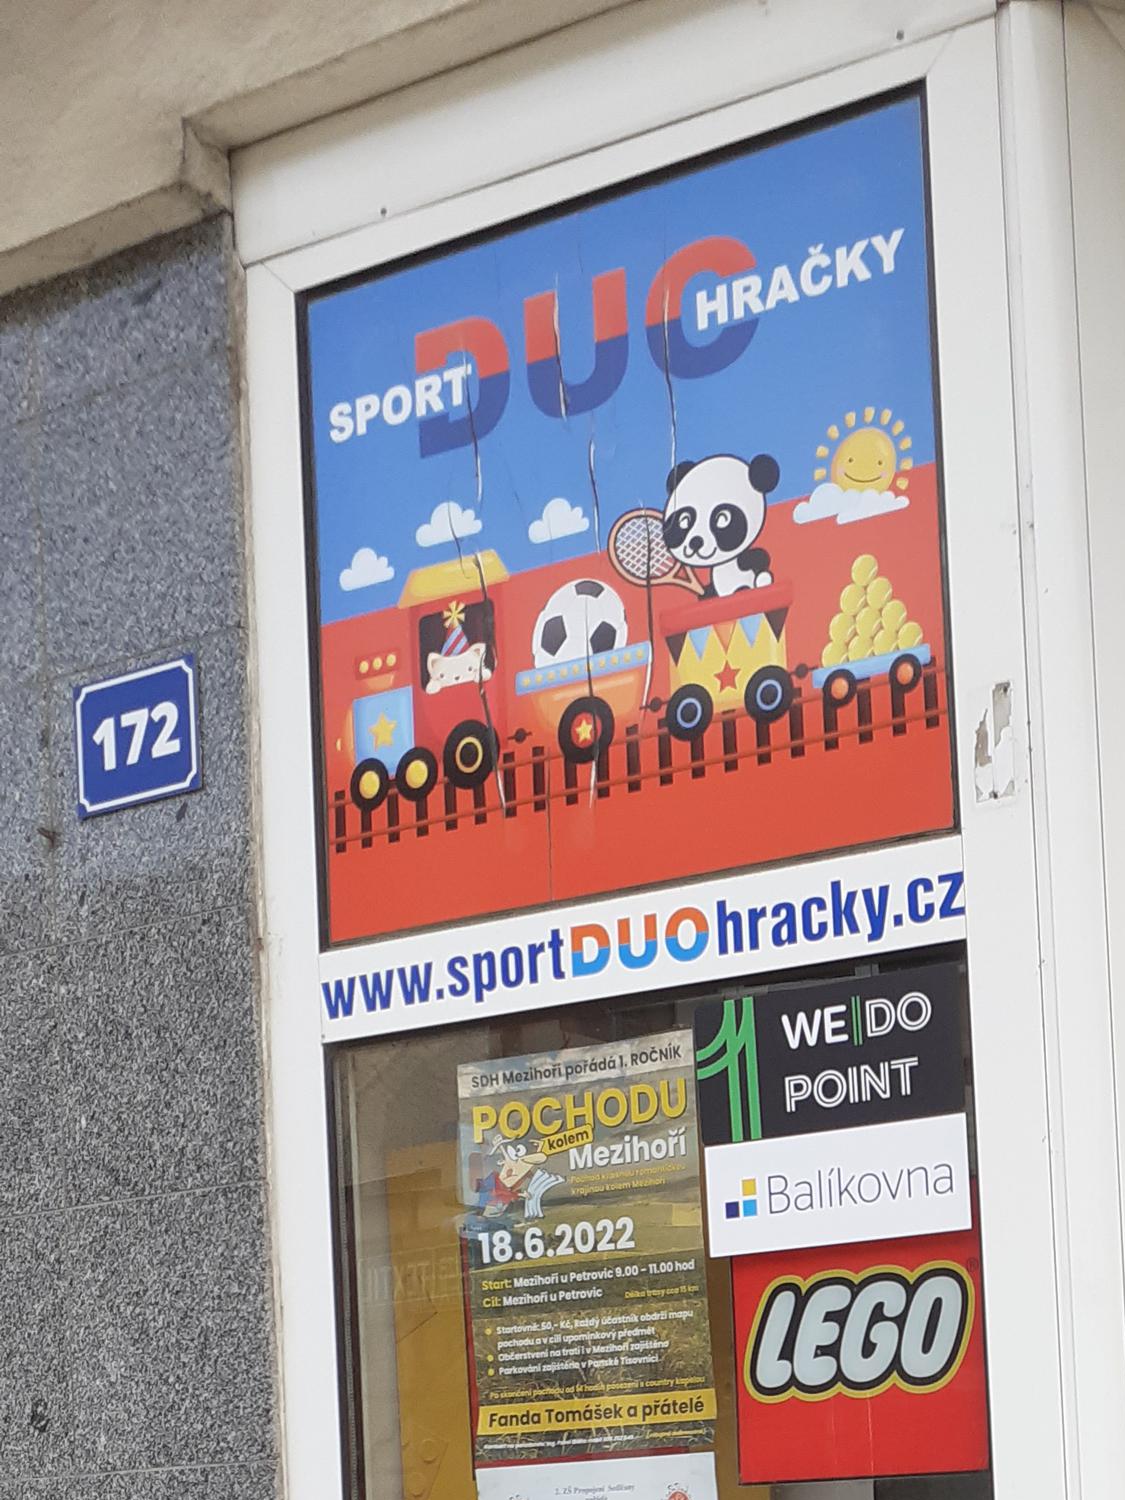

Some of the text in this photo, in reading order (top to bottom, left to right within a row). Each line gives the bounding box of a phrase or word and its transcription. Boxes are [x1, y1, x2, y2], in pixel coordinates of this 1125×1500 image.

[695, 228, 904, 331] HRAČKY
[328, 363, 472, 444] SPORT
[92, 702, 180, 771] 172
[322, 871, 964, 1021] www.sportDUOhracky.cz
[472, 1043, 682, 1088] SDH Mezihoří pořádá 1. ROČNÍK
[784, 1057, 919, 1112] POINT
[472, 1077, 687, 1144] POCHODU
[547, 1129, 589, 1150] kolem
[569, 1128, 686, 1171] Mezihoří
[768, 1162, 956, 1215] Balíkovna
[477, 1217, 635, 1264] 18.6.2022
[482, 1259, 695, 1291] Start: Mezihoří u Petrovic 9.00 11.00 hod
[503, 1289, 547, 1306] Mezihoří
[550, 1293, 556, 1301] u
[559, 1287, 602, 1301] Petrovic
[755, 1273, 966, 1390] LEGO
[488, 1397, 704, 1428] Fanda Tomášek a přátelé
